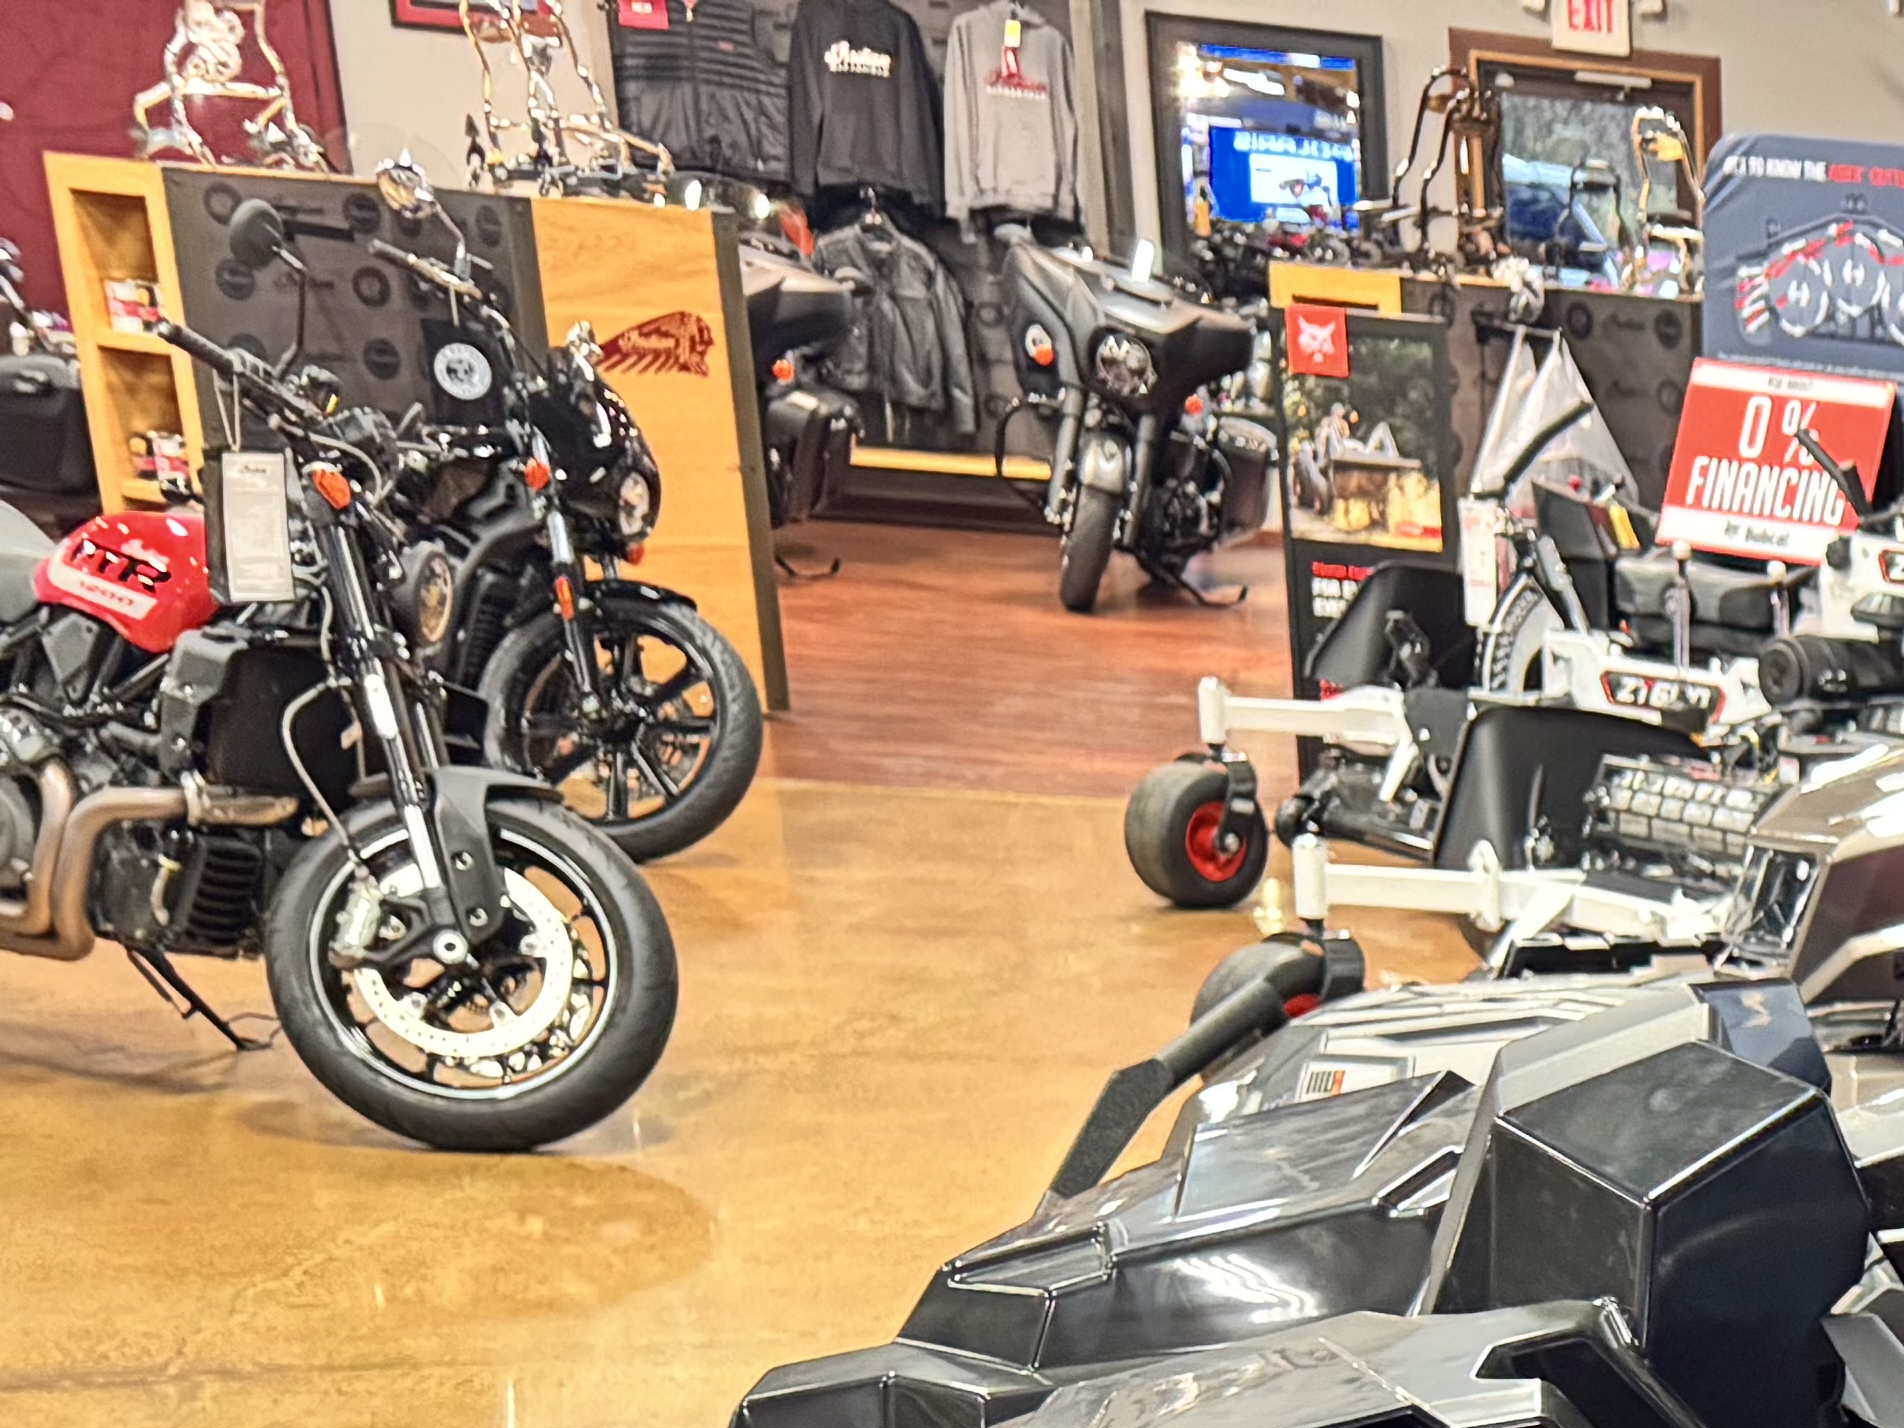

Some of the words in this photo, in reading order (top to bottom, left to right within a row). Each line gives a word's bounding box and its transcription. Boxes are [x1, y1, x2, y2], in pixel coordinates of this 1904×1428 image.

[1567, 0, 1613, 33] EXIT
[1739, 396, 1772, 459] 0
[1781, 399, 1819, 465] %
[1685, 456, 1846, 526] FINANCING
